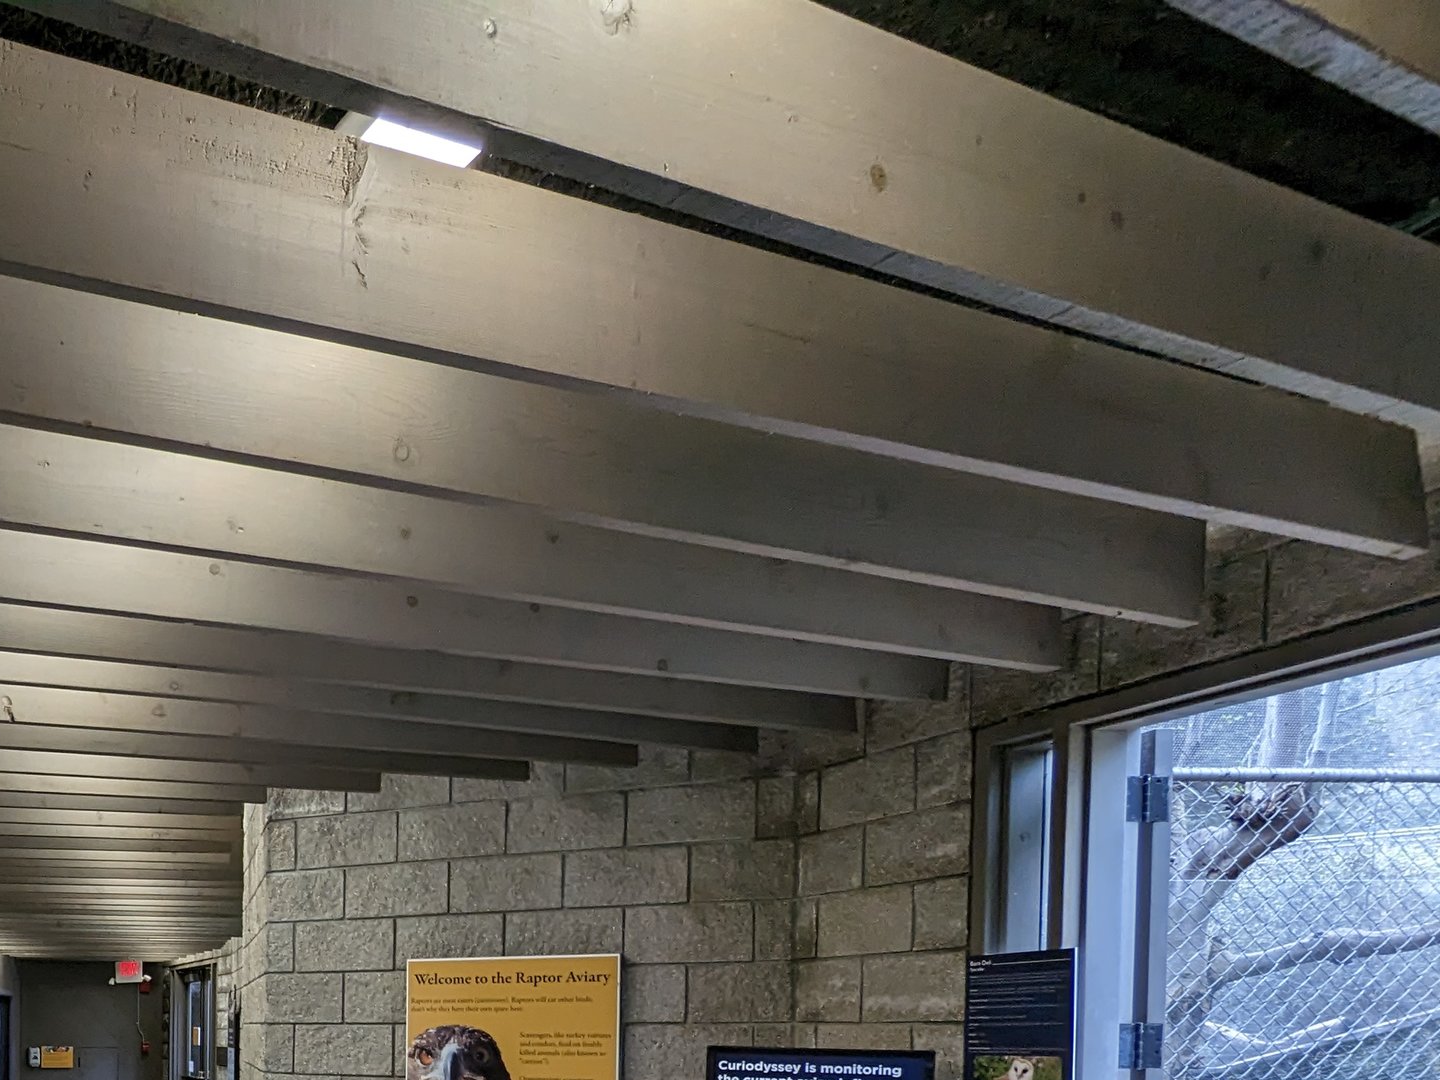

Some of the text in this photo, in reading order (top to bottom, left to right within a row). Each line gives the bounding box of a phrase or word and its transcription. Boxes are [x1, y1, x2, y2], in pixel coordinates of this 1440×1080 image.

[415, 971, 612, 987] Welcome to the Raptor Aviary
[718, 1060, 902, 1078] Curiodyssey is monitoring
